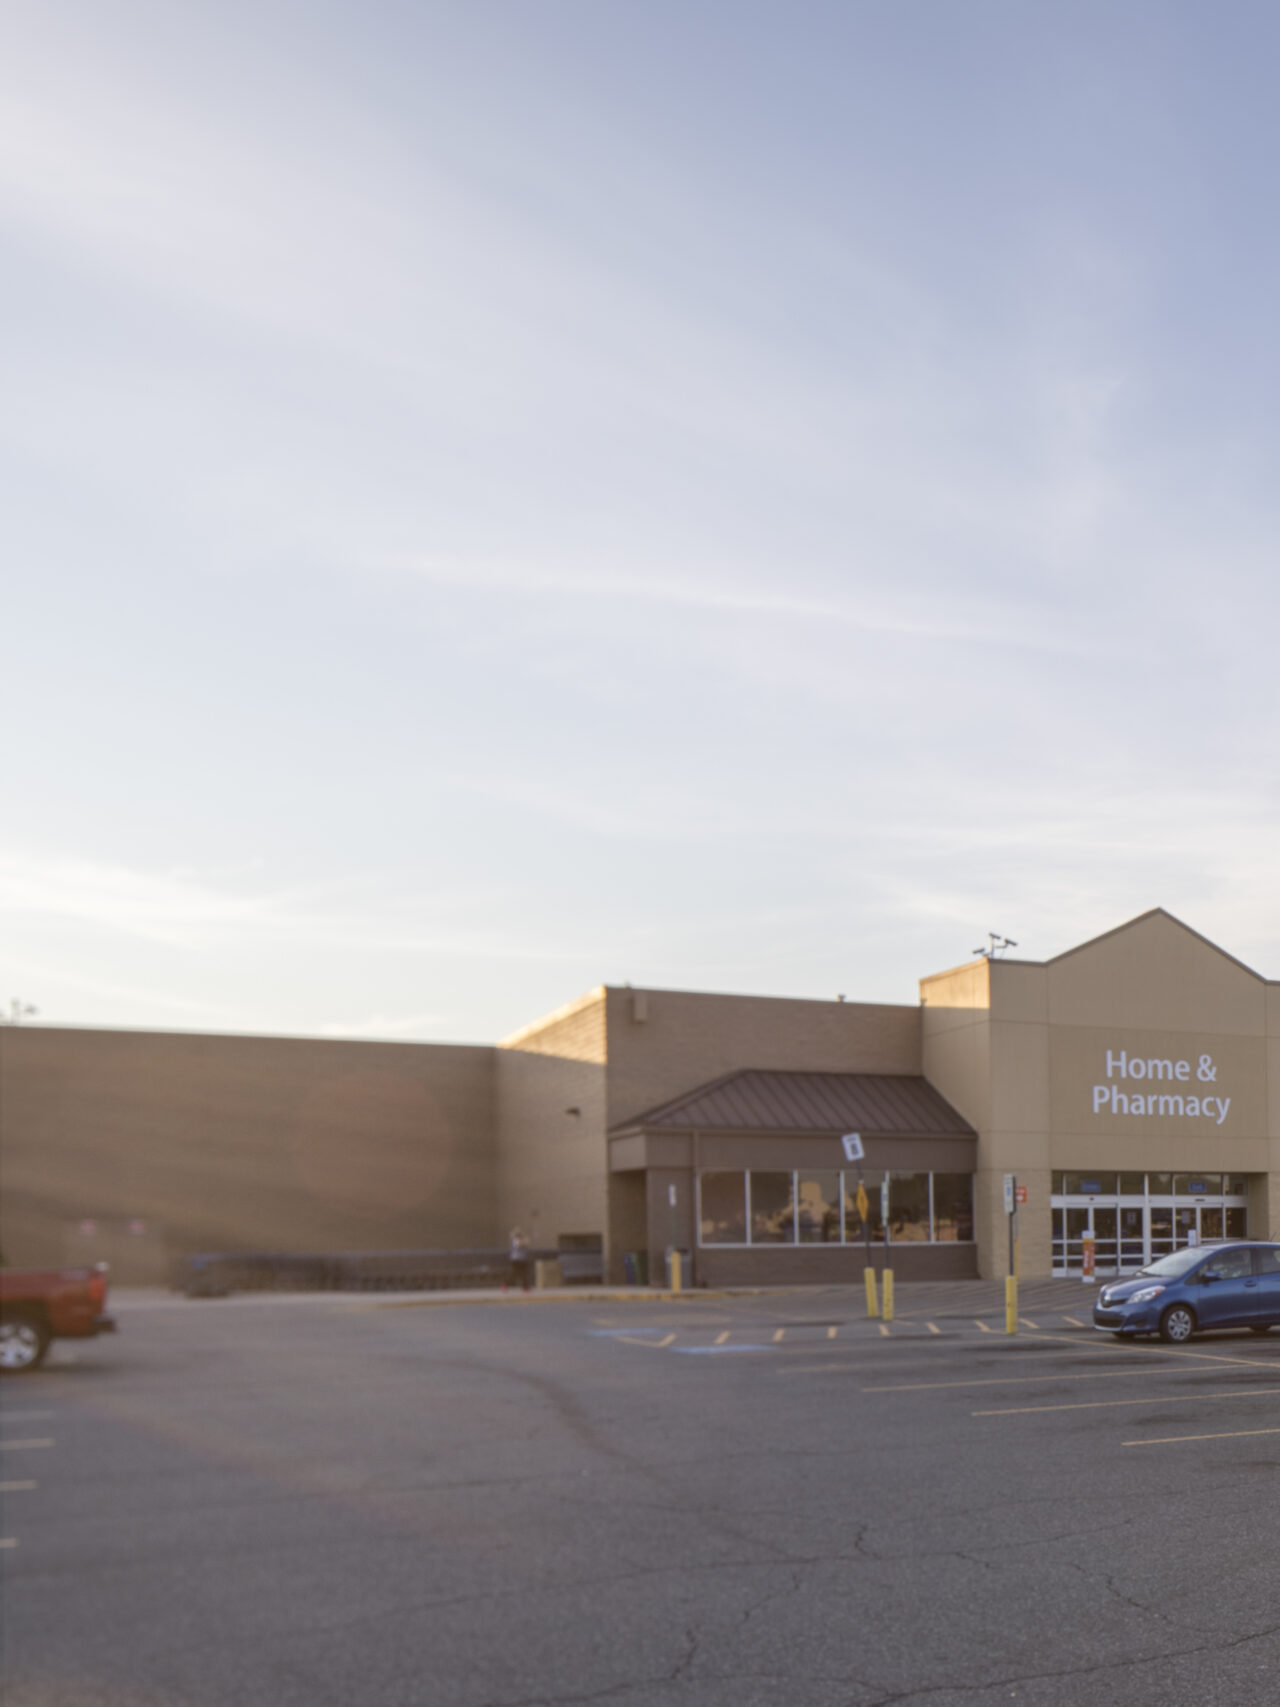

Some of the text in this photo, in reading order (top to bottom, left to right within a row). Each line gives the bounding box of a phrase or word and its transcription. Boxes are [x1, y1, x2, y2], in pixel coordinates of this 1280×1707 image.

[1106, 1050, 1217, 1081] Home &
[1093, 1085, 1230, 1125] Pharmacy
